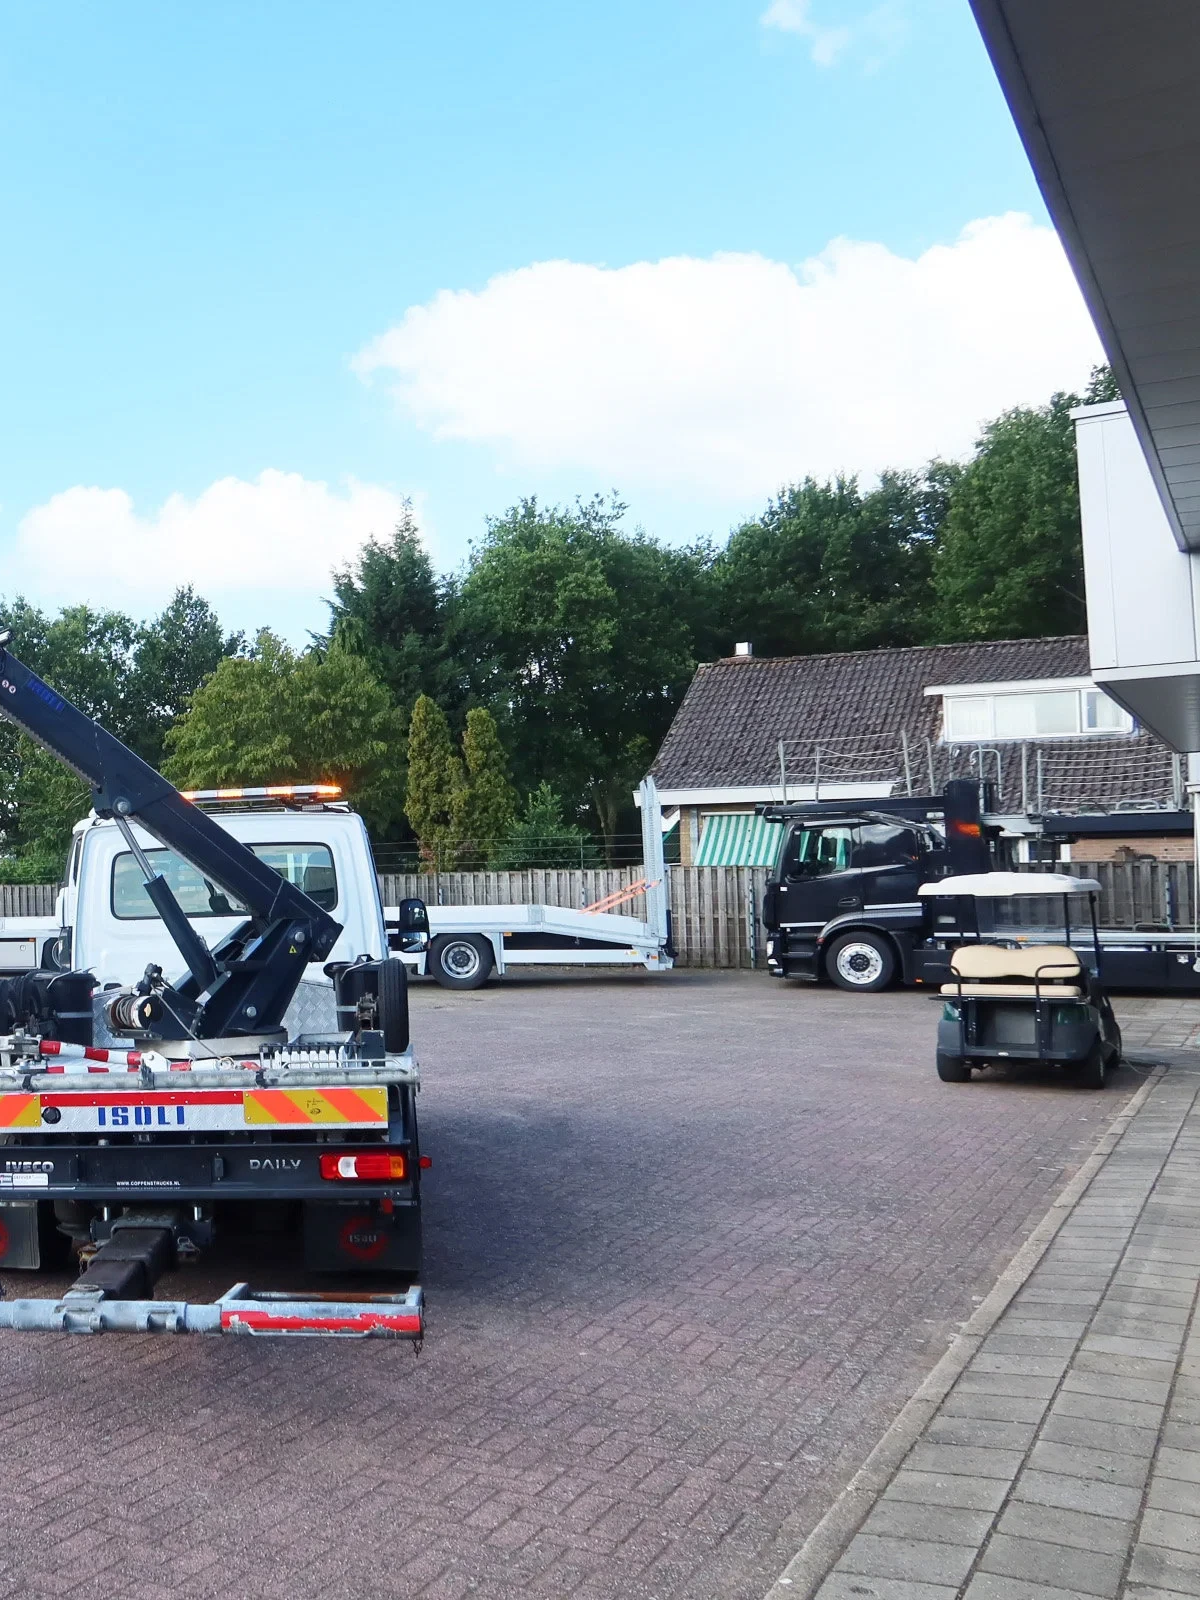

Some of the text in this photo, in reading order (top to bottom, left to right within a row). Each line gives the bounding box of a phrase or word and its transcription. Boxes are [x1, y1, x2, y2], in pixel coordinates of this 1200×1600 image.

[97, 1105, 185, 1126] ISOLI
[5, 1160, 54, 1172] IVECO
[249, 1159, 301, 1170] DAILY
